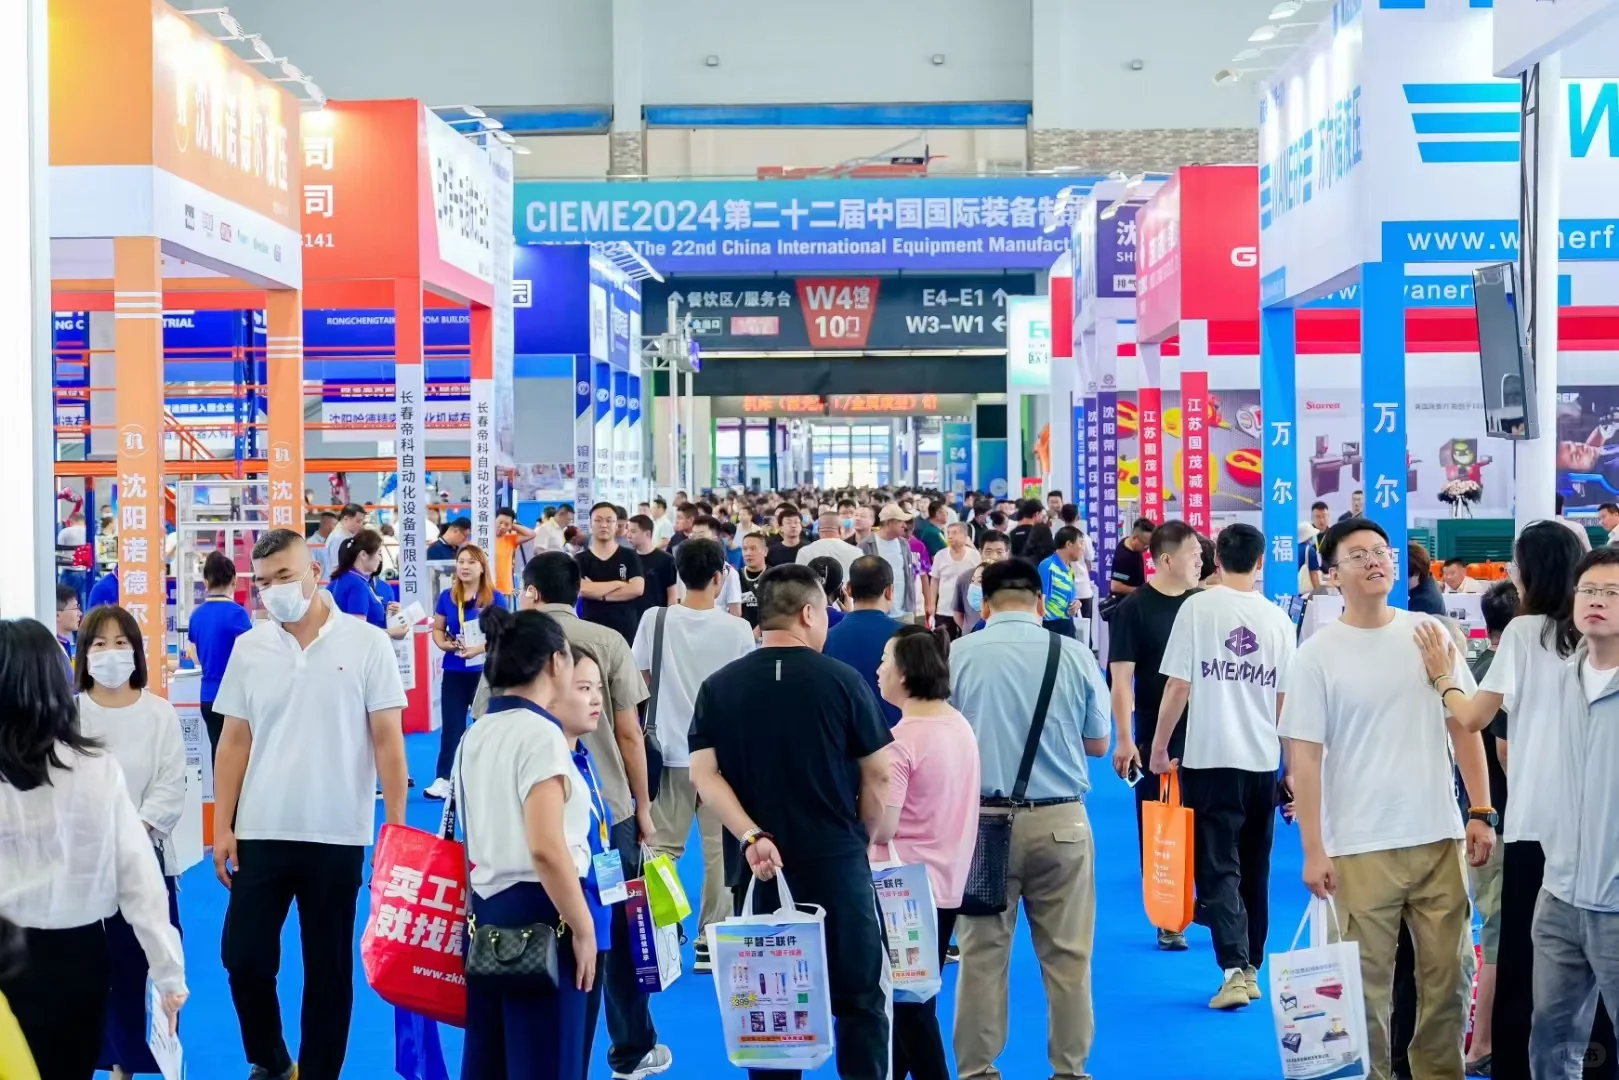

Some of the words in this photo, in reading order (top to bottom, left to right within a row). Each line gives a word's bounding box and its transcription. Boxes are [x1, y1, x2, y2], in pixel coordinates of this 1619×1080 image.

[304, 136, 334, 171] 司
[303, 184, 334, 218] 司
[526, 200, 720, 232] CIEME2024
[635, 240, 666, 256] The
[672, 239, 716, 256] 22nd
[723, 239, 771, 255] China
[777, 238, 886, 255] International
[893, 237, 983, 257] Equipment
[1117, 251, 1136, 262] SH
[687, 291, 791, 308] 餐饮区/服务台
[476, 401, 489, 558] 长春帝科自动化设备有限
[1187, 398, 1204, 527] 江苏国茂减速机
[400, 390, 418, 594] 长春帝科自动化设备有限公司
[383, 864, 467, 916] 卖工
[734, 997, 750, 1008] 399
